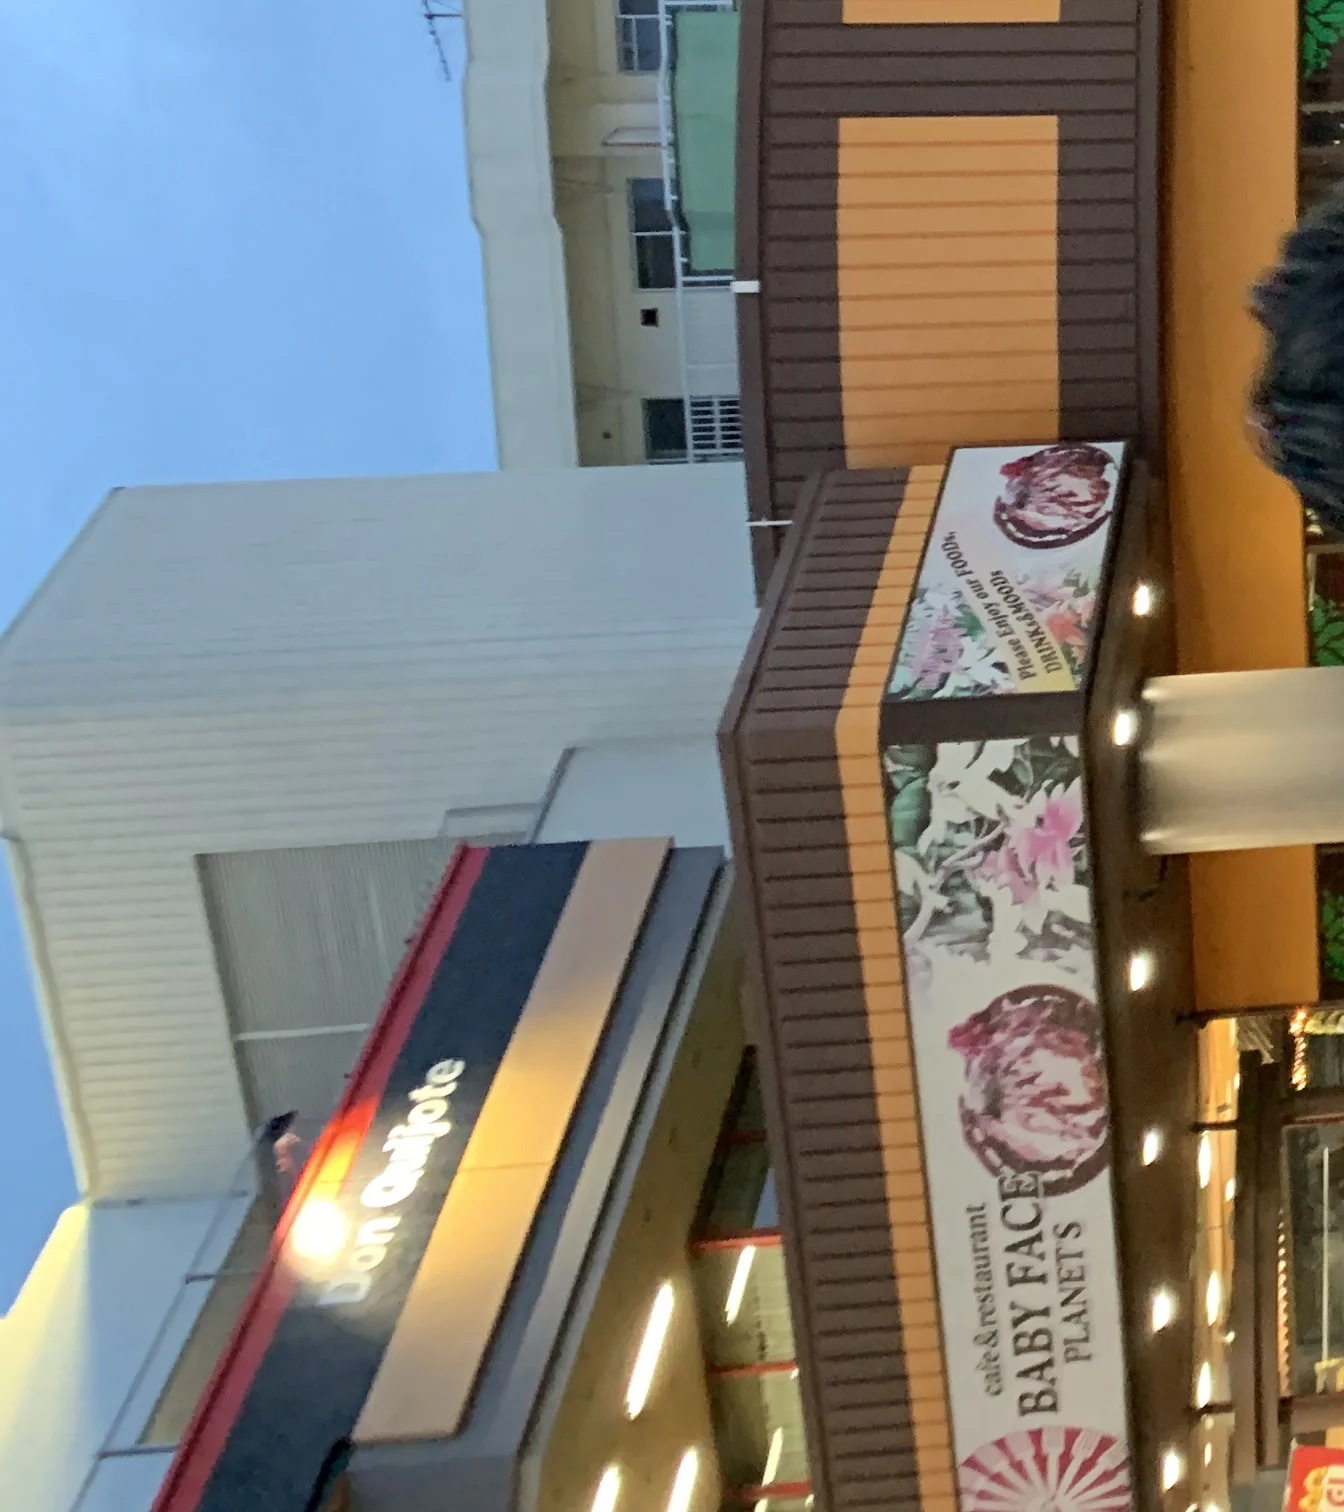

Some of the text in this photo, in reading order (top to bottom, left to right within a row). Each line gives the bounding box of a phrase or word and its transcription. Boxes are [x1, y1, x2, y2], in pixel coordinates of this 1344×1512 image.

[964, 578, 989, 600] our
[983, 601, 1015, 638] Enjoy
[1007, 637, 1037, 681] Please
[315, 1056, 466, 1306] Don Quijote
[997, 1171, 1058, 1417] BABY FACE
